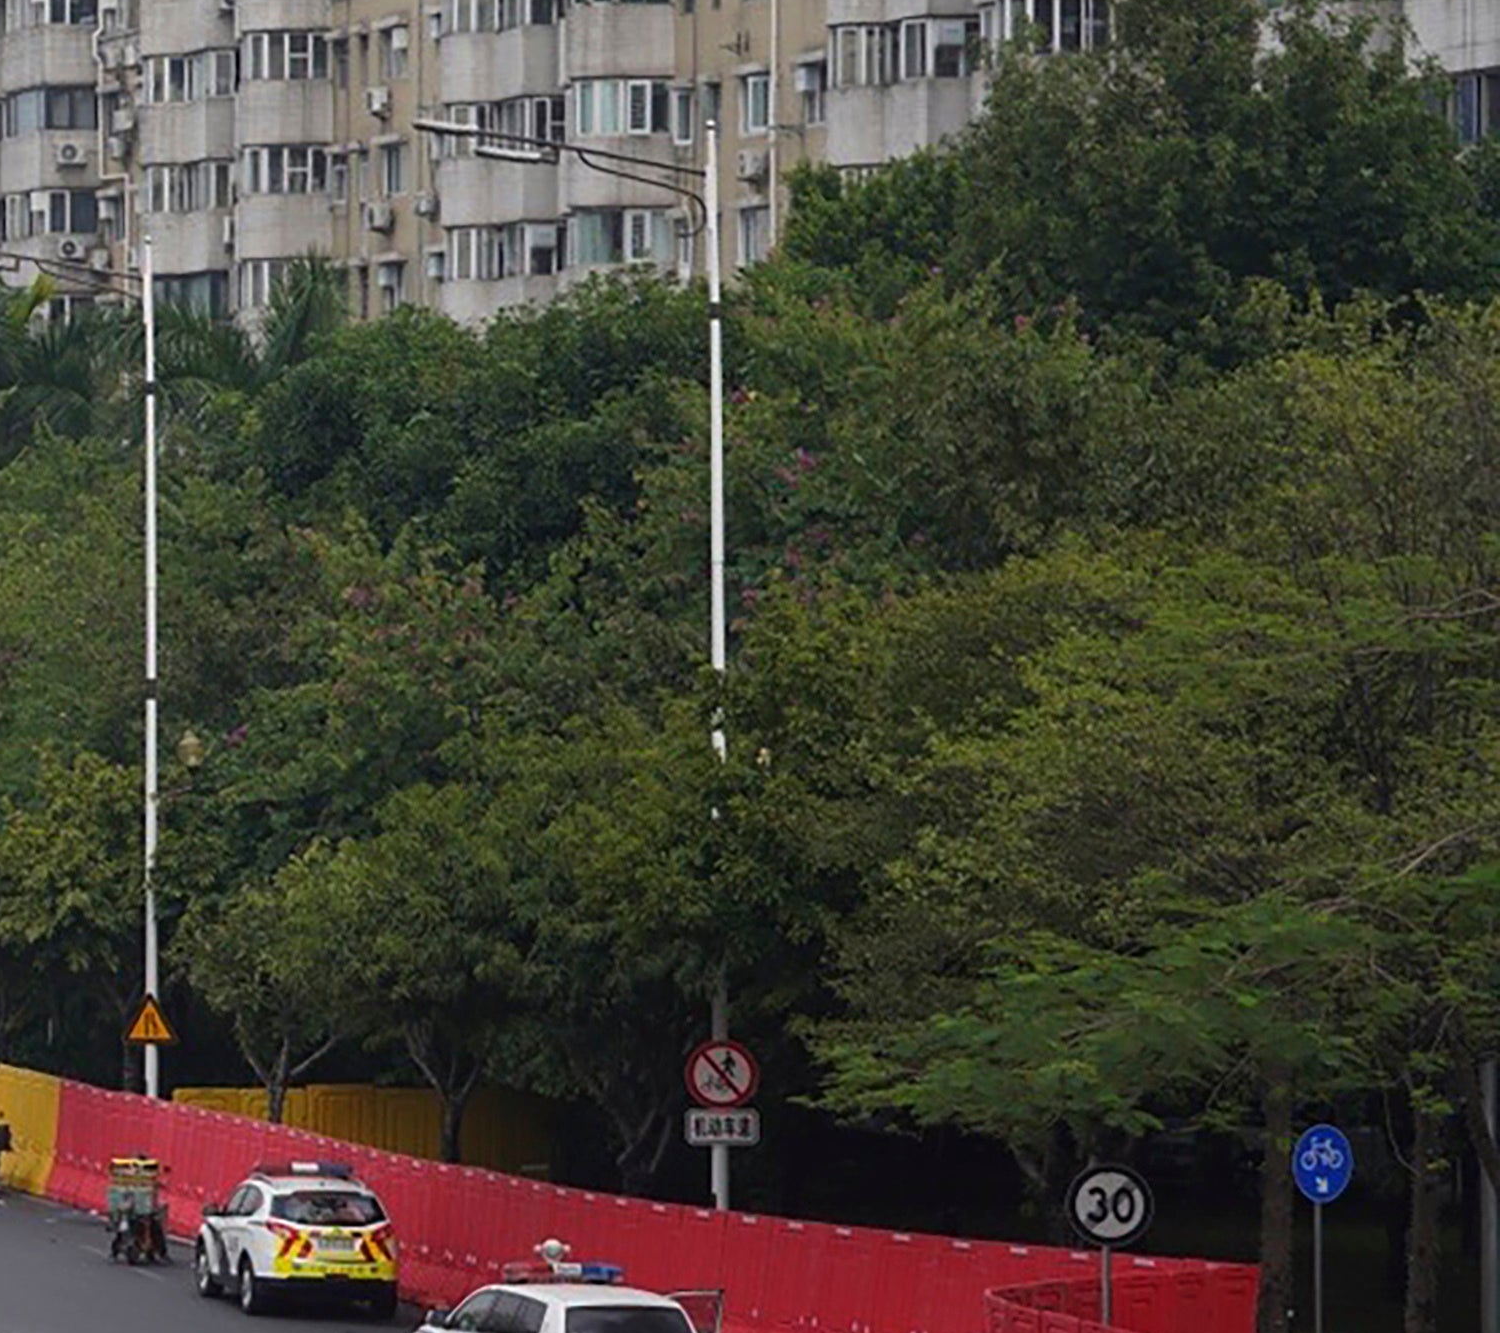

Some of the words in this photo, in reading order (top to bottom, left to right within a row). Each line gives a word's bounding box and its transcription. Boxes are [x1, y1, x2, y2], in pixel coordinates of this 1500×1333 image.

[693, 1116, 752, 1137] 机动车道
[1087, 1186, 1136, 1224] 30
